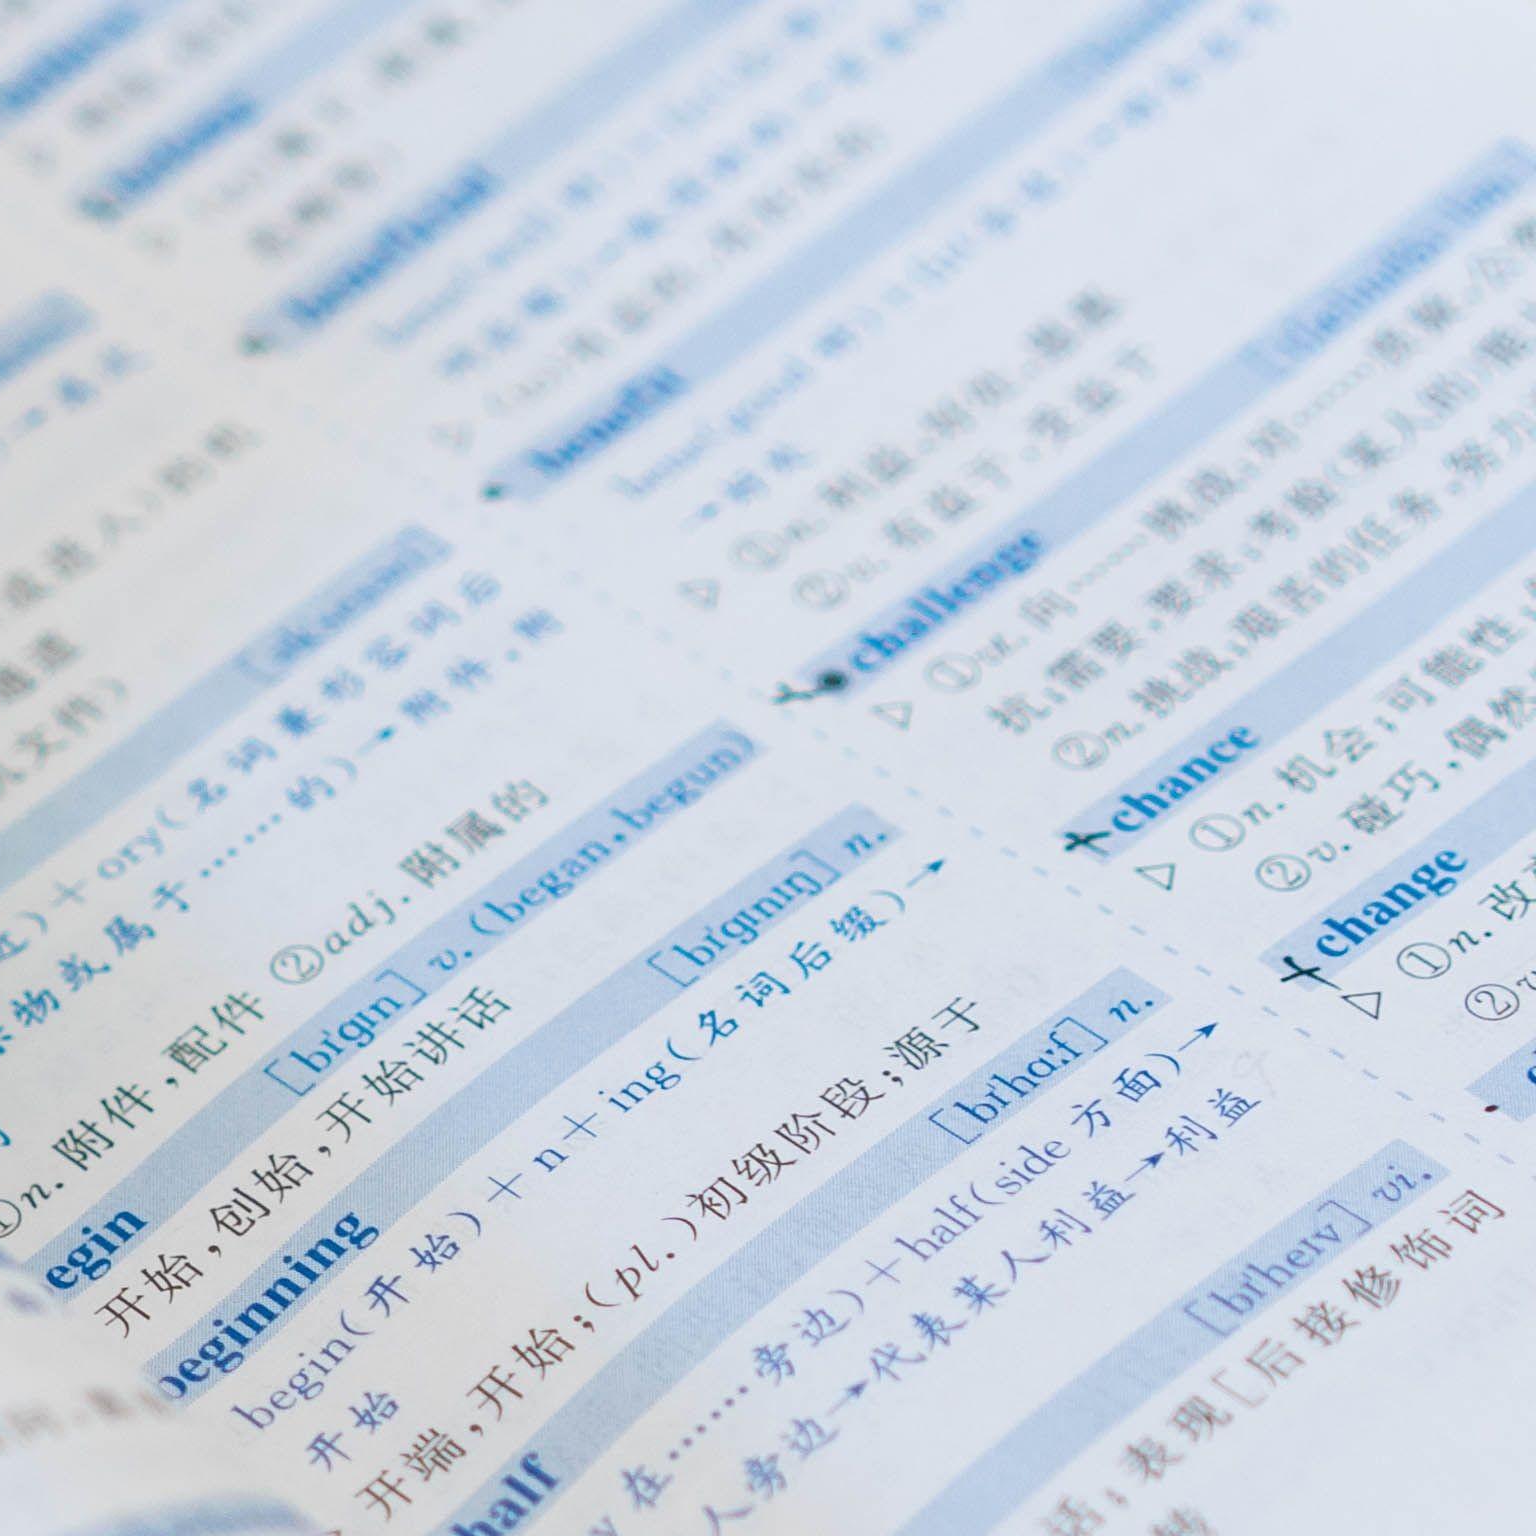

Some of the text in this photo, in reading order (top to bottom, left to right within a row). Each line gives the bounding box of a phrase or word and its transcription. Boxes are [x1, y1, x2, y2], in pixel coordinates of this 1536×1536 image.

[1109, 724, 1263, 834] chance
[1315, 848, 1469, 958] change
[1478, 855, 1536, 923] 改
[46, 1204, 149, 1294] egin
[305, 1389, 401, 1473] 开始
